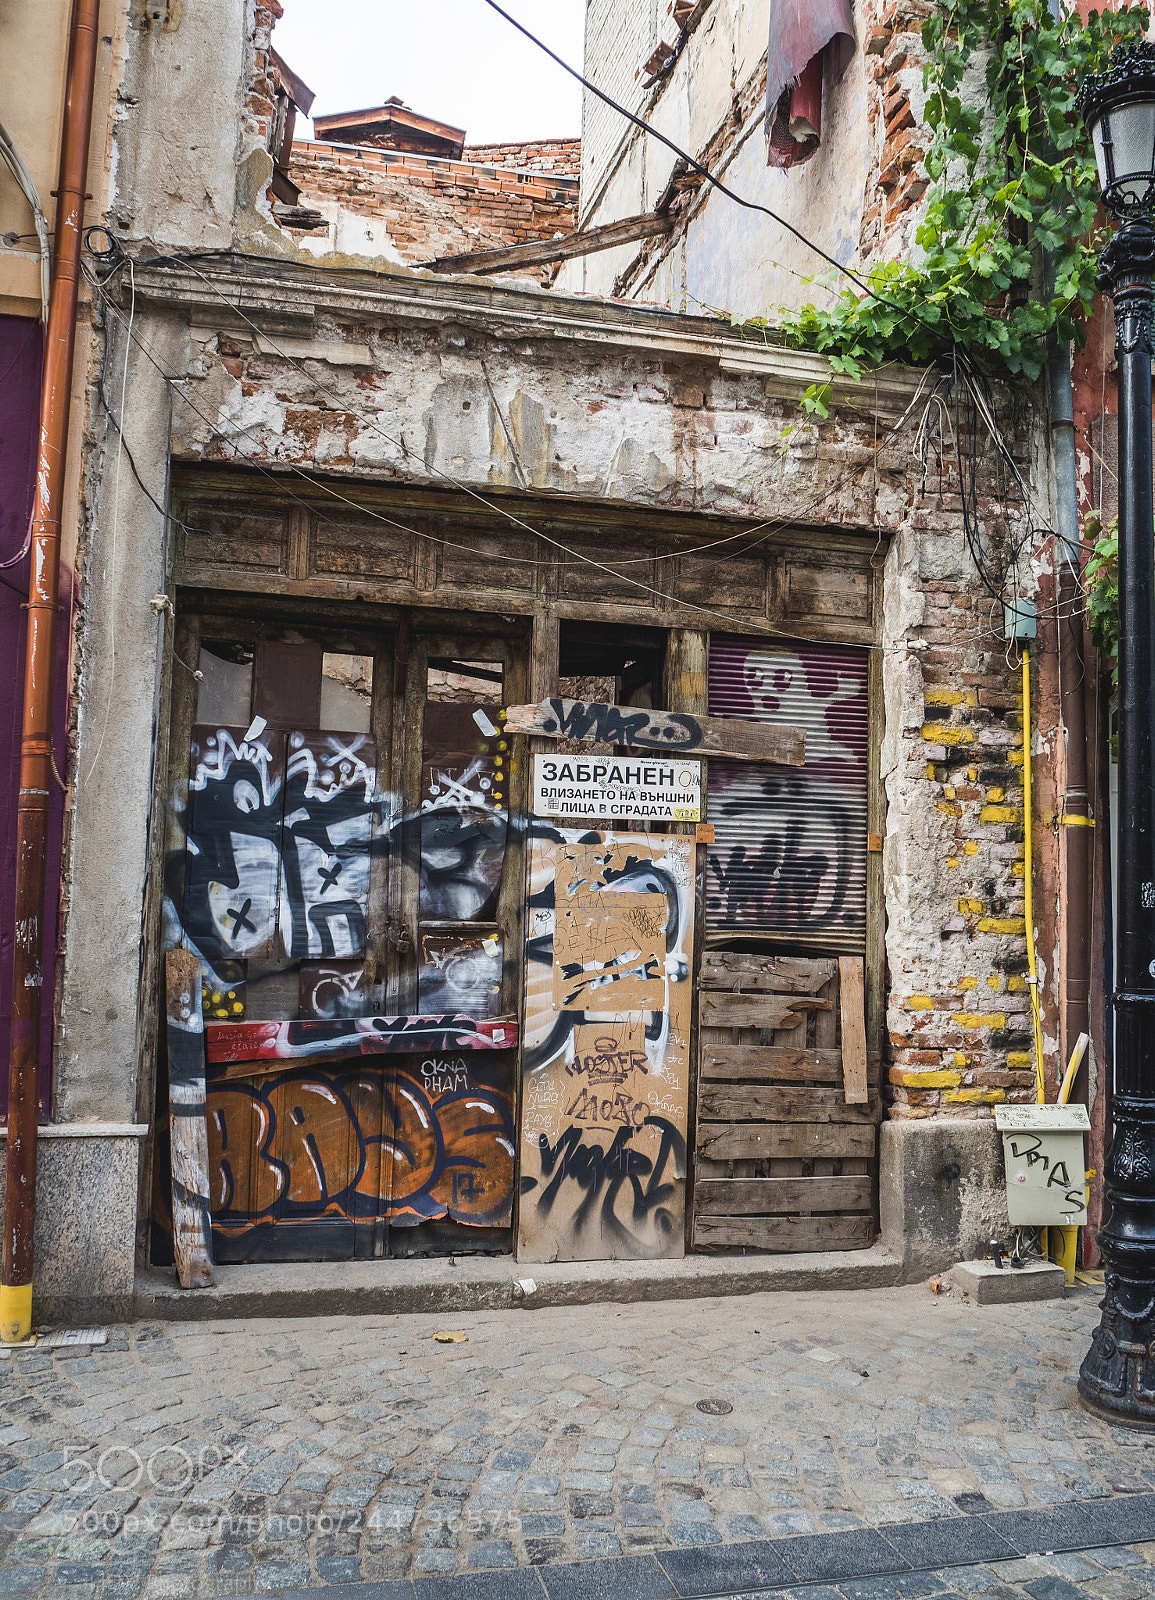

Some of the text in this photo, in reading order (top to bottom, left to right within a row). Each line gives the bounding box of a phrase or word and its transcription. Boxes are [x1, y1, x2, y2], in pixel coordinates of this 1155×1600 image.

[542, 762, 674, 786] ЗАБРАНЕН
[541, 787, 694, 803] ВЛИЗАНЕТО НА ВЪНШНИ
[560, 802, 595, 815] ЛИЦА
[599, 804, 607, 814] В
[610, 804, 672, 817] СГРАДАТА
